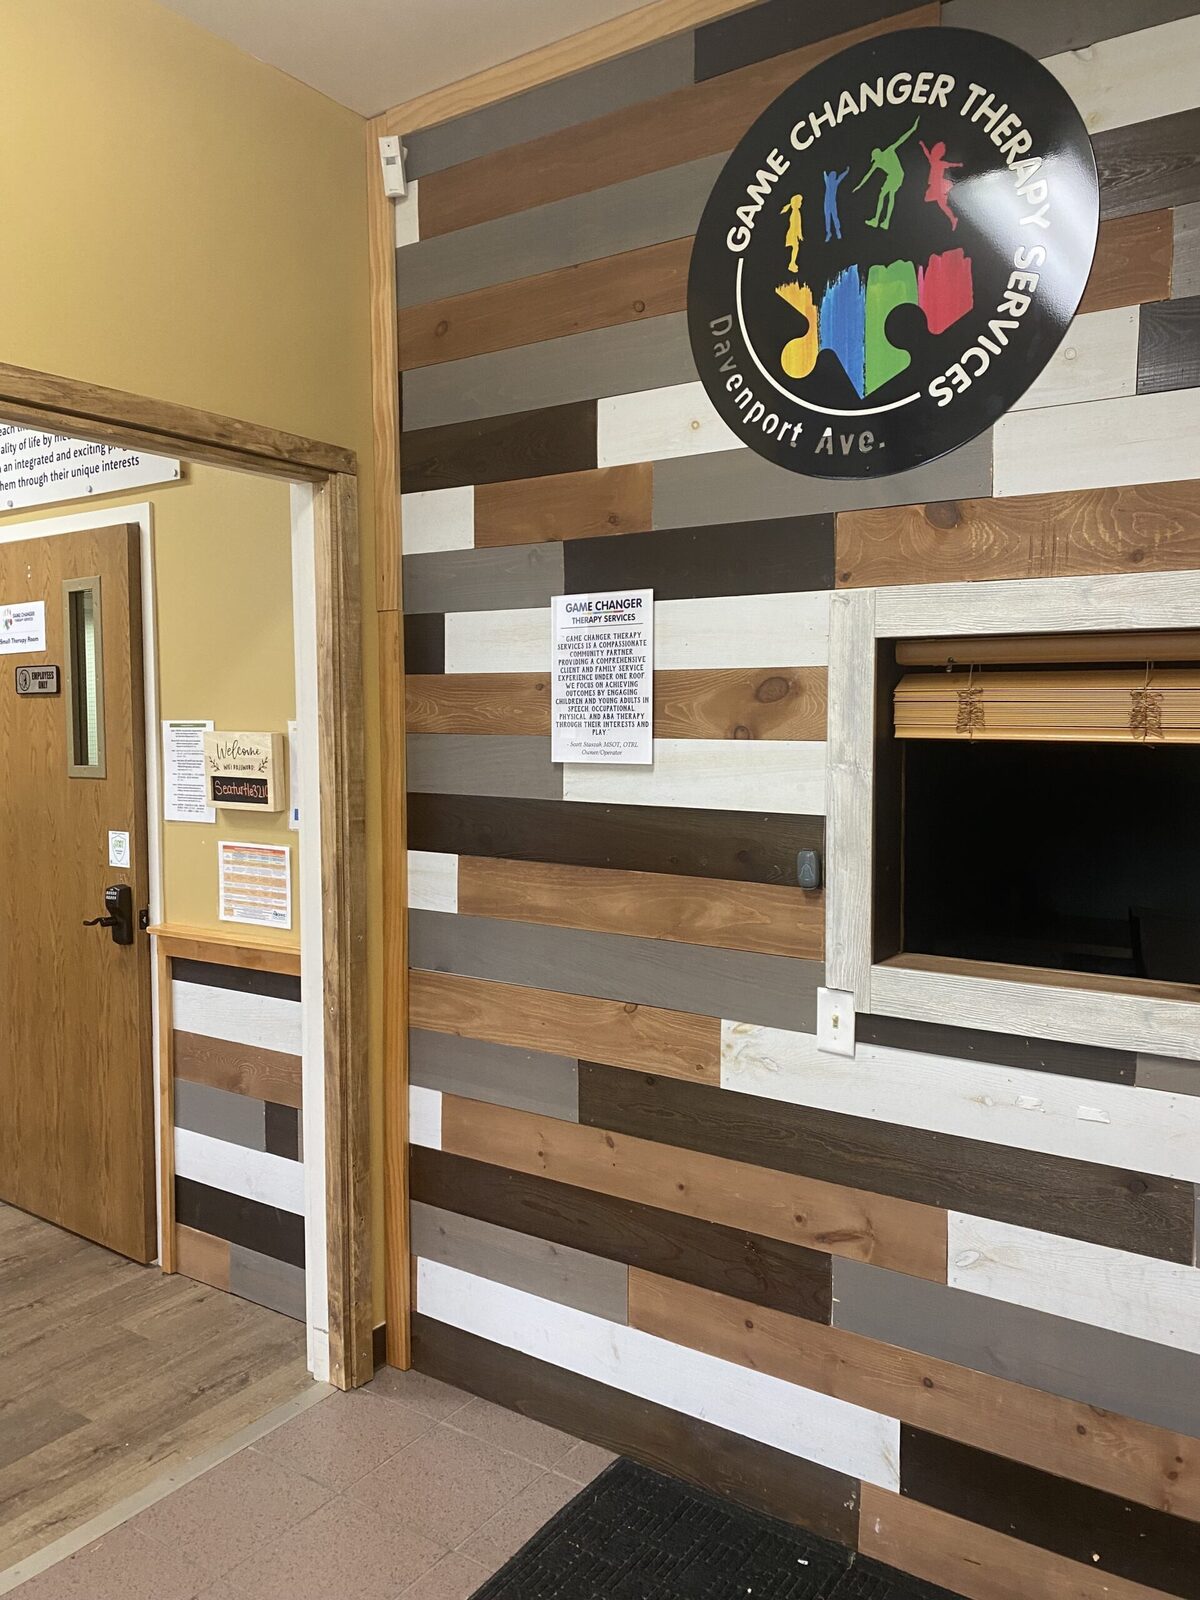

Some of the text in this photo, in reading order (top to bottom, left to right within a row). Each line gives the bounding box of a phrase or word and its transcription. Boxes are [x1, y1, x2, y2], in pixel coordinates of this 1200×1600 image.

[726, 72, 1052, 408] GAME CHANGER THERAPY SERVICES
[708, 313, 886, 456] Davenport Ave.
[18, 438, 26, 450] of
[28, 435, 40, 448] life
[42, 434, 52, 448] by
[4, 463, 12, 472] an
[14, 451, 54, 470] integrated
[56, 448, 71, 462] and
[74, 444, 106, 458] exciting
[18, 472, 48, 487] through
[50, 468, 69, 482] their
[71, 464, 100, 478] unique
[102, 456, 140, 472] interests
[566, 598, 642, 613] GAME CHANGER
[572, 613, 636, 624] THERAPY SERVICES
[599, 640, 647, 648] COMPASSIONATE
[596, 656, 646, 664] COMPREHENSIVE
[32, 671, 54, 680] EMPLOYEES
[38, 680, 48, 689] ONLY
[216, 739, 261, 759] Welcome
